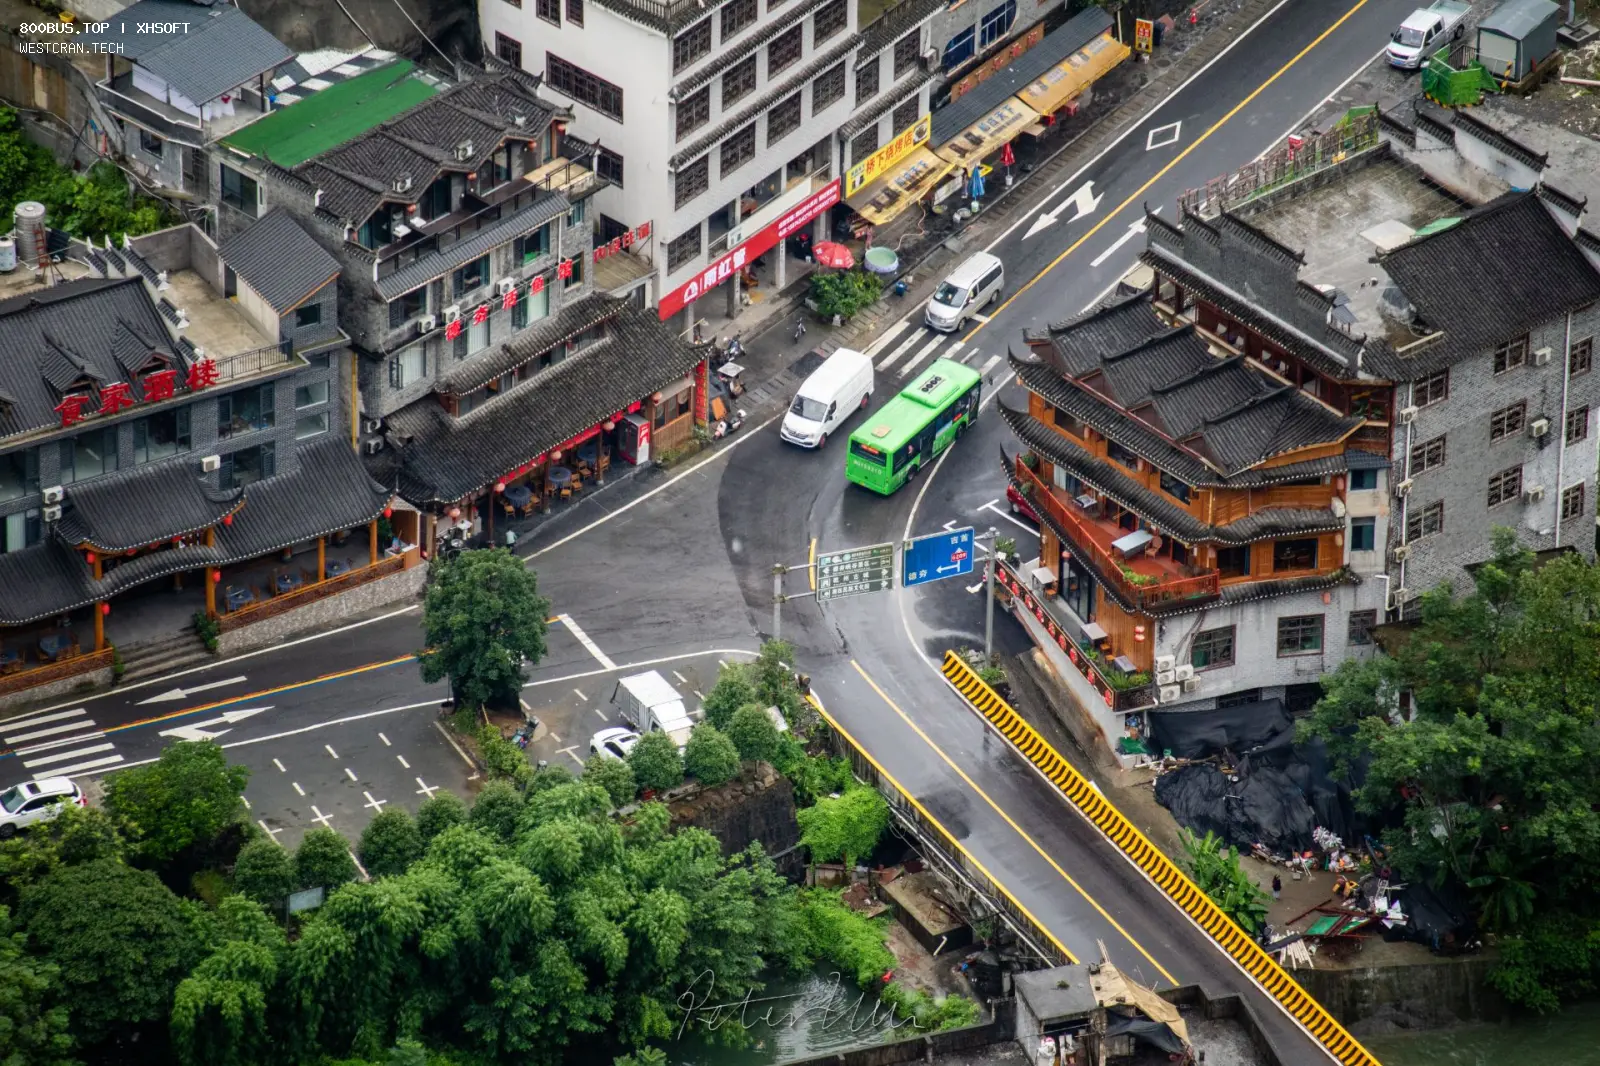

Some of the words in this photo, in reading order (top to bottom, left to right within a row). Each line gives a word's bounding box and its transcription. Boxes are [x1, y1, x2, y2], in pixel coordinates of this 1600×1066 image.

[866, 131, 913, 175] 桥下烧烤店
[950, 533, 969, 545] 吉首
[908, 569, 928, 581] 德夯
